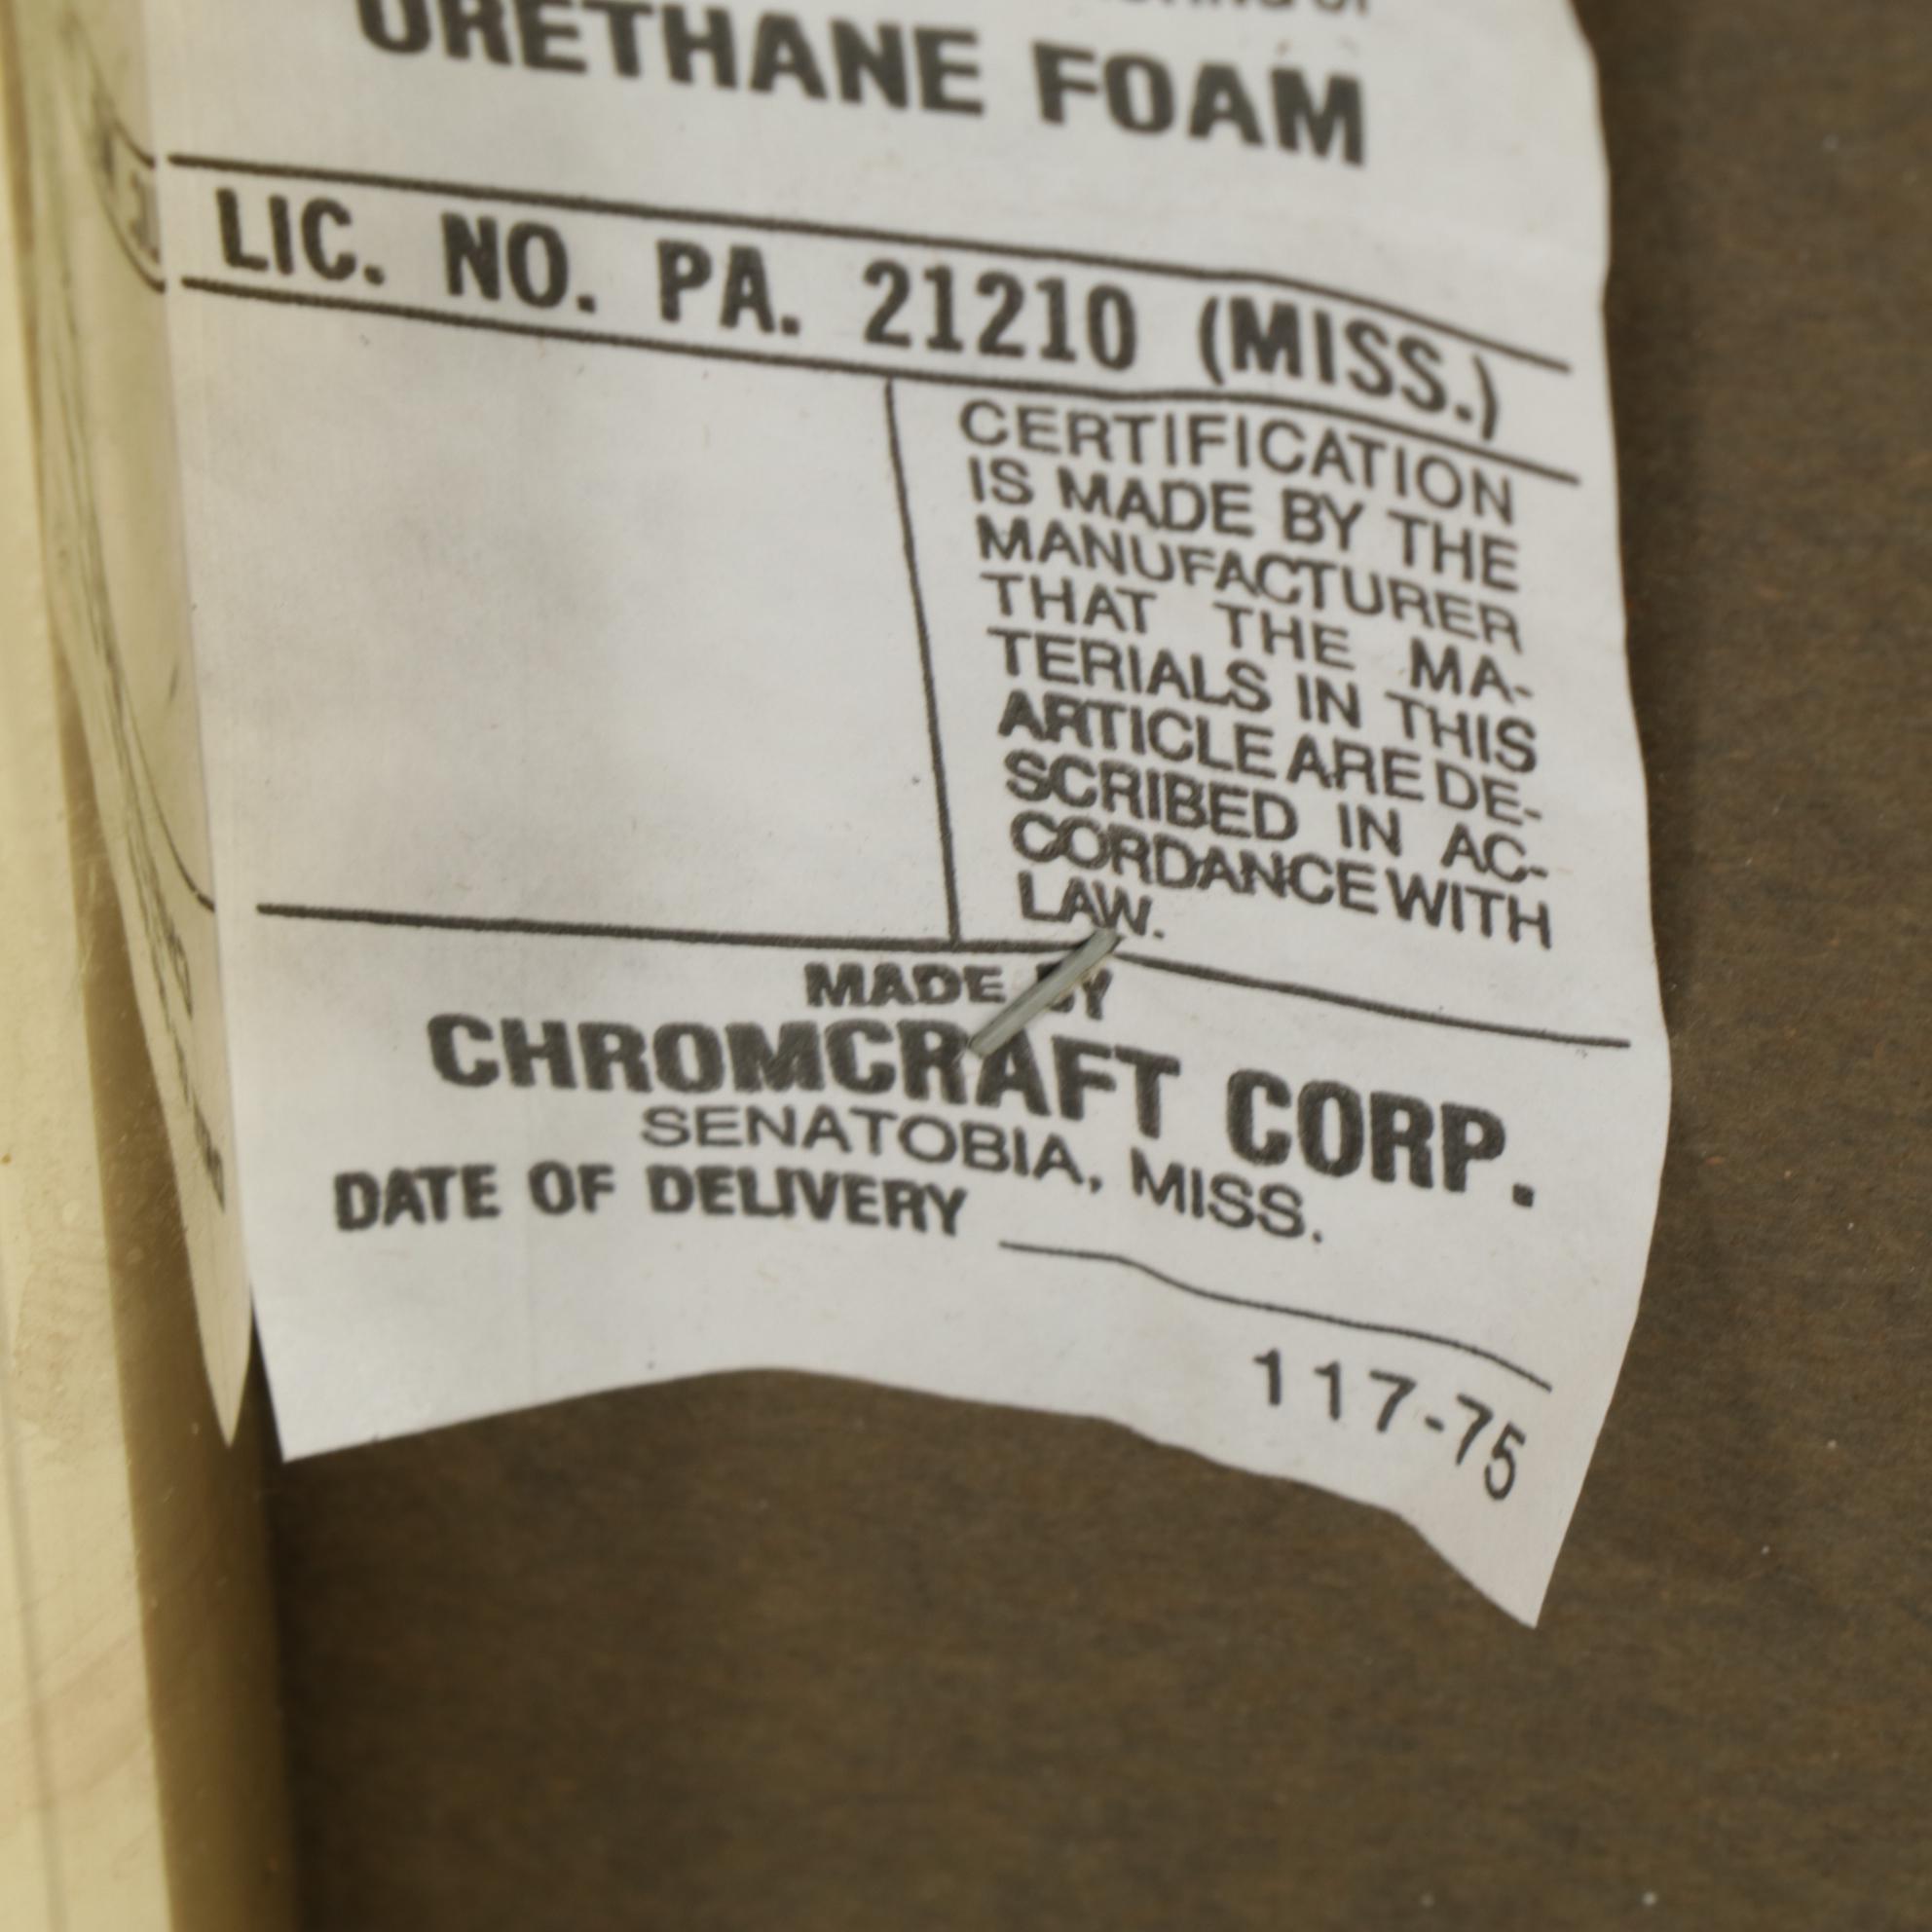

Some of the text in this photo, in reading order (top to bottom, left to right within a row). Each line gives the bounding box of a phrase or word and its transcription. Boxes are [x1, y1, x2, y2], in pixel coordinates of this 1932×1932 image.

[355, 0, 1366, 167] URETHANE FOAM
[216, 188, 386, 285] LIC.
[440, 211, 596, 314] NO.
[656, 239, 800, 337] PA.
[863, 260, 1137, 373] 21210
[1199, 295, 1501, 440] (MISS.)
[960, 399, 1514, 526] CERTIFICATION
[969, 457, 1518, 592] IS MADE BY THE
[976, 514, 1523, 654] MANUFACTURER
[980, 573, 1533, 703] THAT THE MA-
[986, 626, 1538, 775] TERIALS IN THIS
[998, 689, 1542, 827] ARTICLE ARE DE-
[1004, 749, 1548, 883] SCRIBED IN AC-
[1010, 811, 1552, 949] CORDANCE WITH
[1017, 873, 1165, 939] LAW.
[804, 962, 1006, 1007] MADE
[427, 1013, 1535, 1208] CHROMCRAFT CORP.
[641, 1104, 1322, 1243] SENATOBIA, MISS.
[334, 1160, 967, 1237] DATE OF DELIVERY
[1253, 1348, 1527, 1501] 117-75
